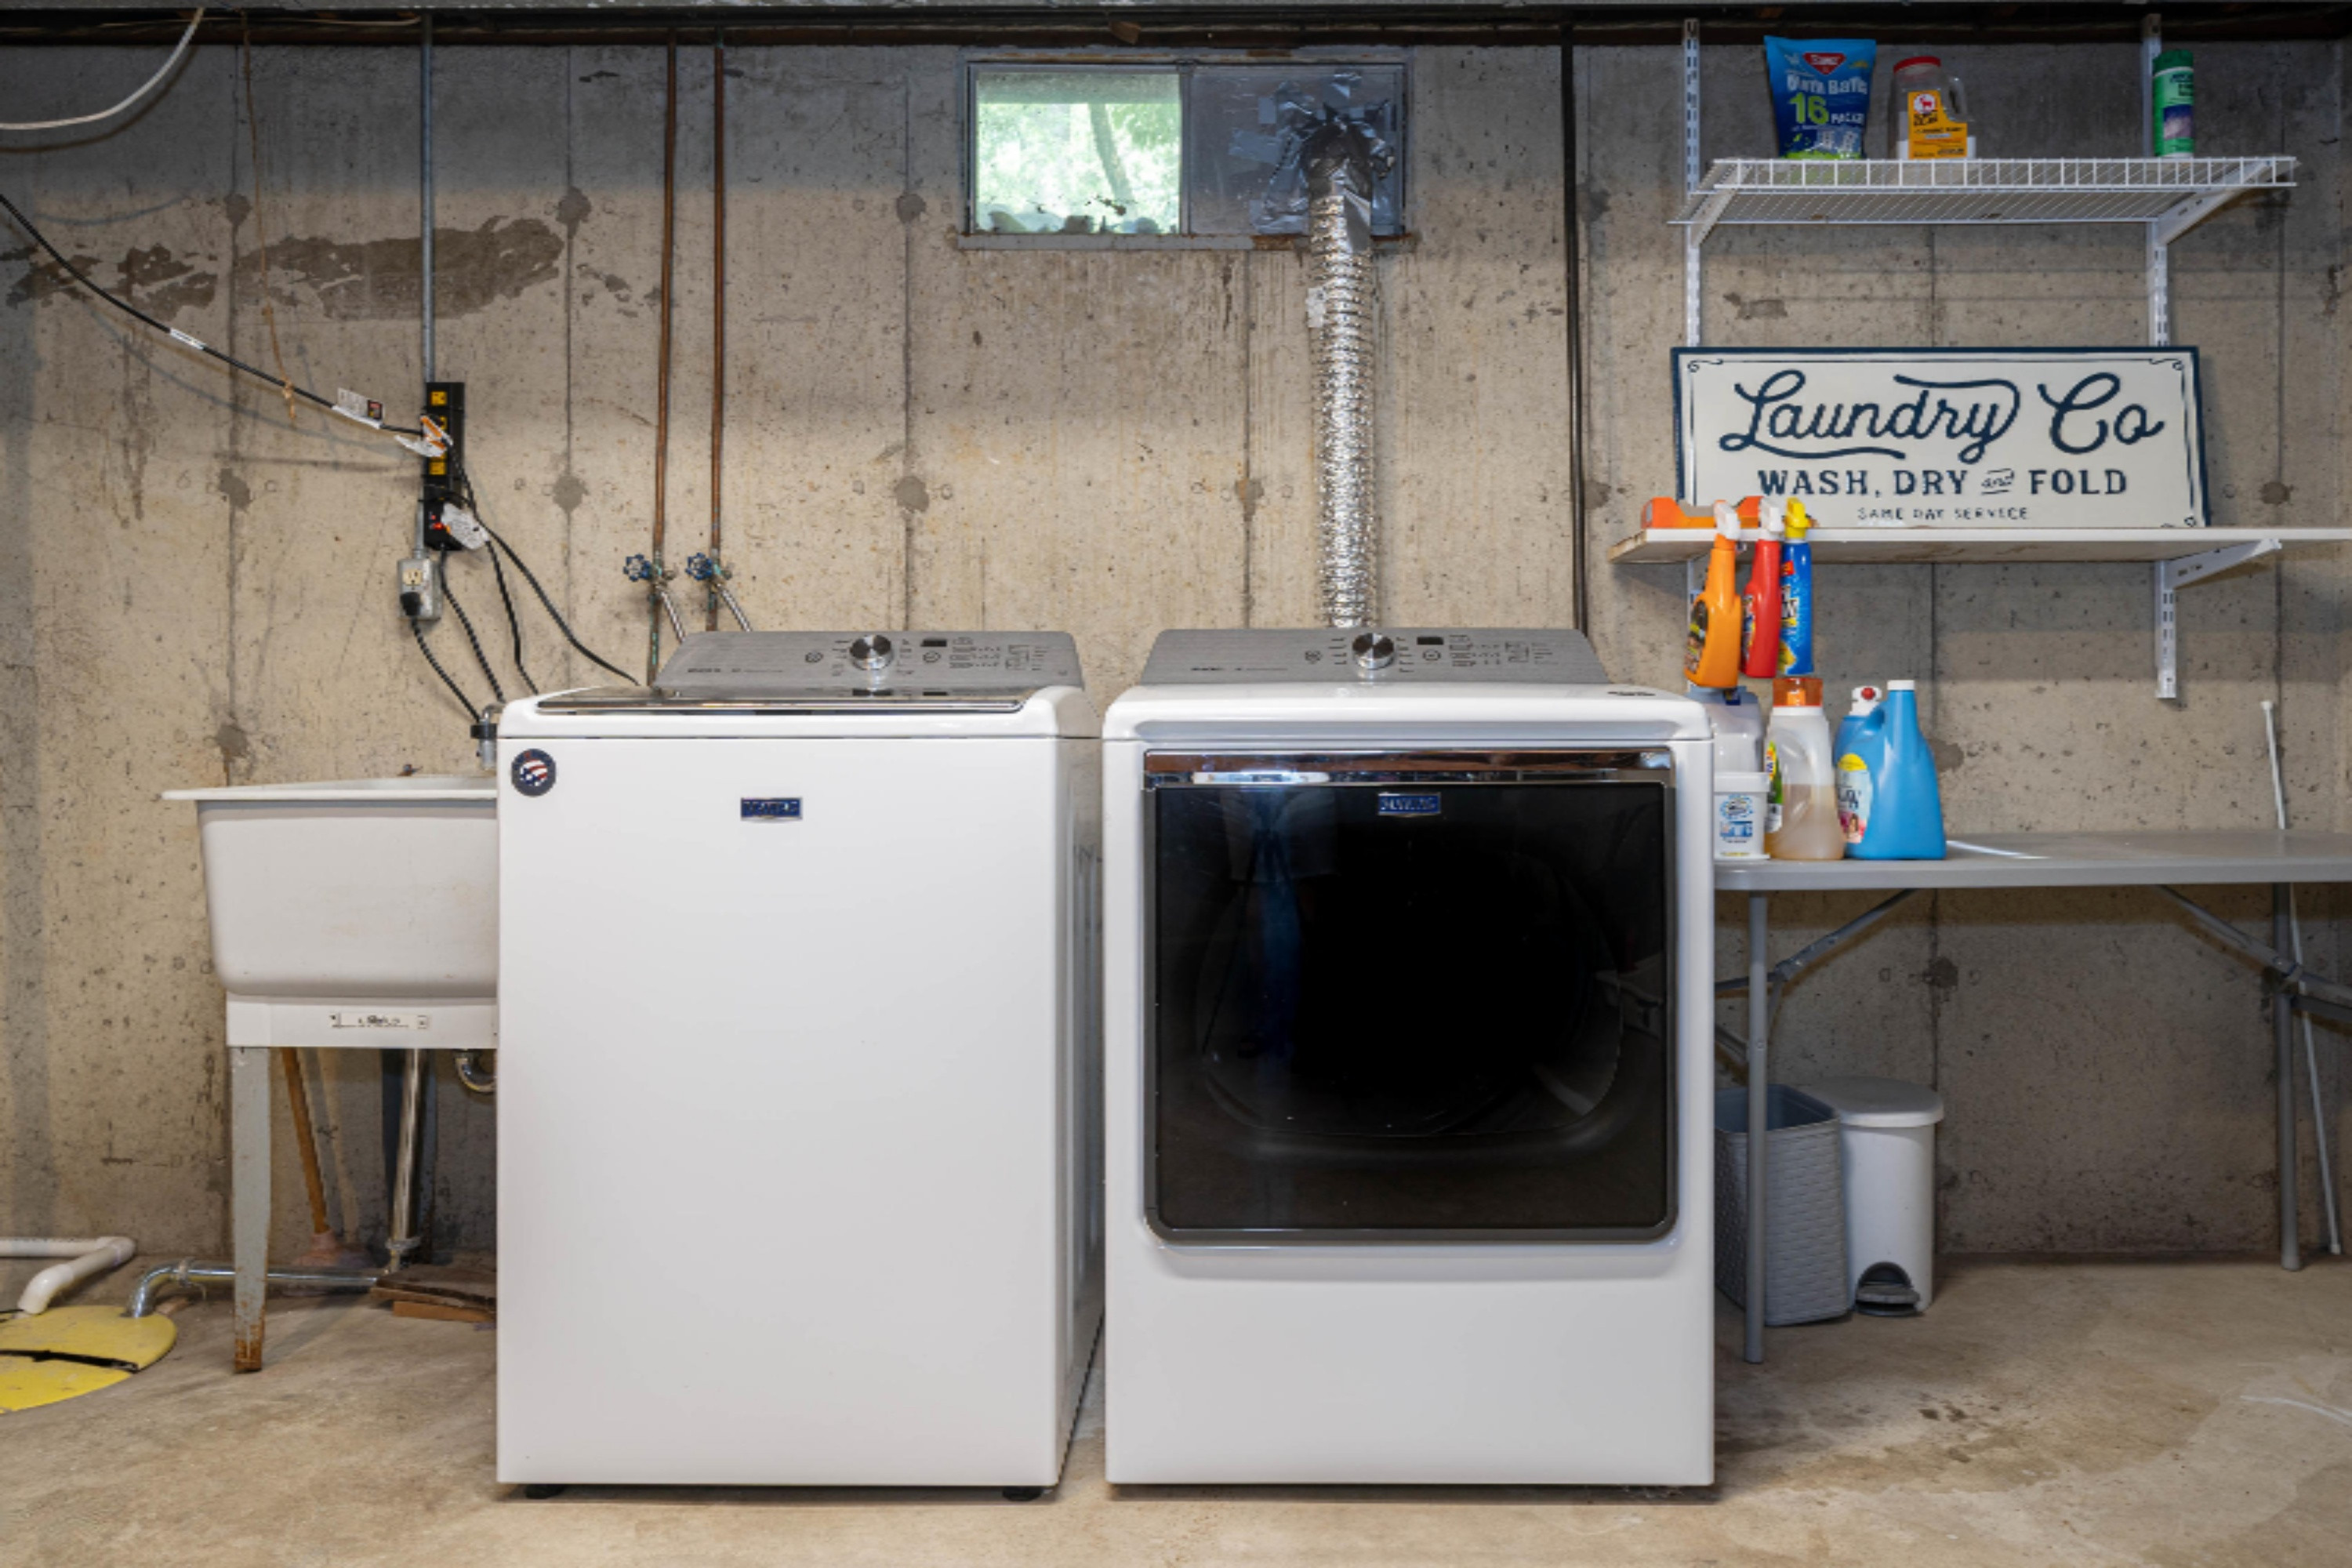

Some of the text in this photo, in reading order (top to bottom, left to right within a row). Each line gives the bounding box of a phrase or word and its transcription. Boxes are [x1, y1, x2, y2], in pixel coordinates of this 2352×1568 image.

[1789, 92, 1829, 125] 16
[1719, 369, 2165, 465] Laundry Co
[1758, 469, 2127, 498] WASH, DRY and FOLD
[1857, 506, 2028, 521] SAME DAY SERVICE
